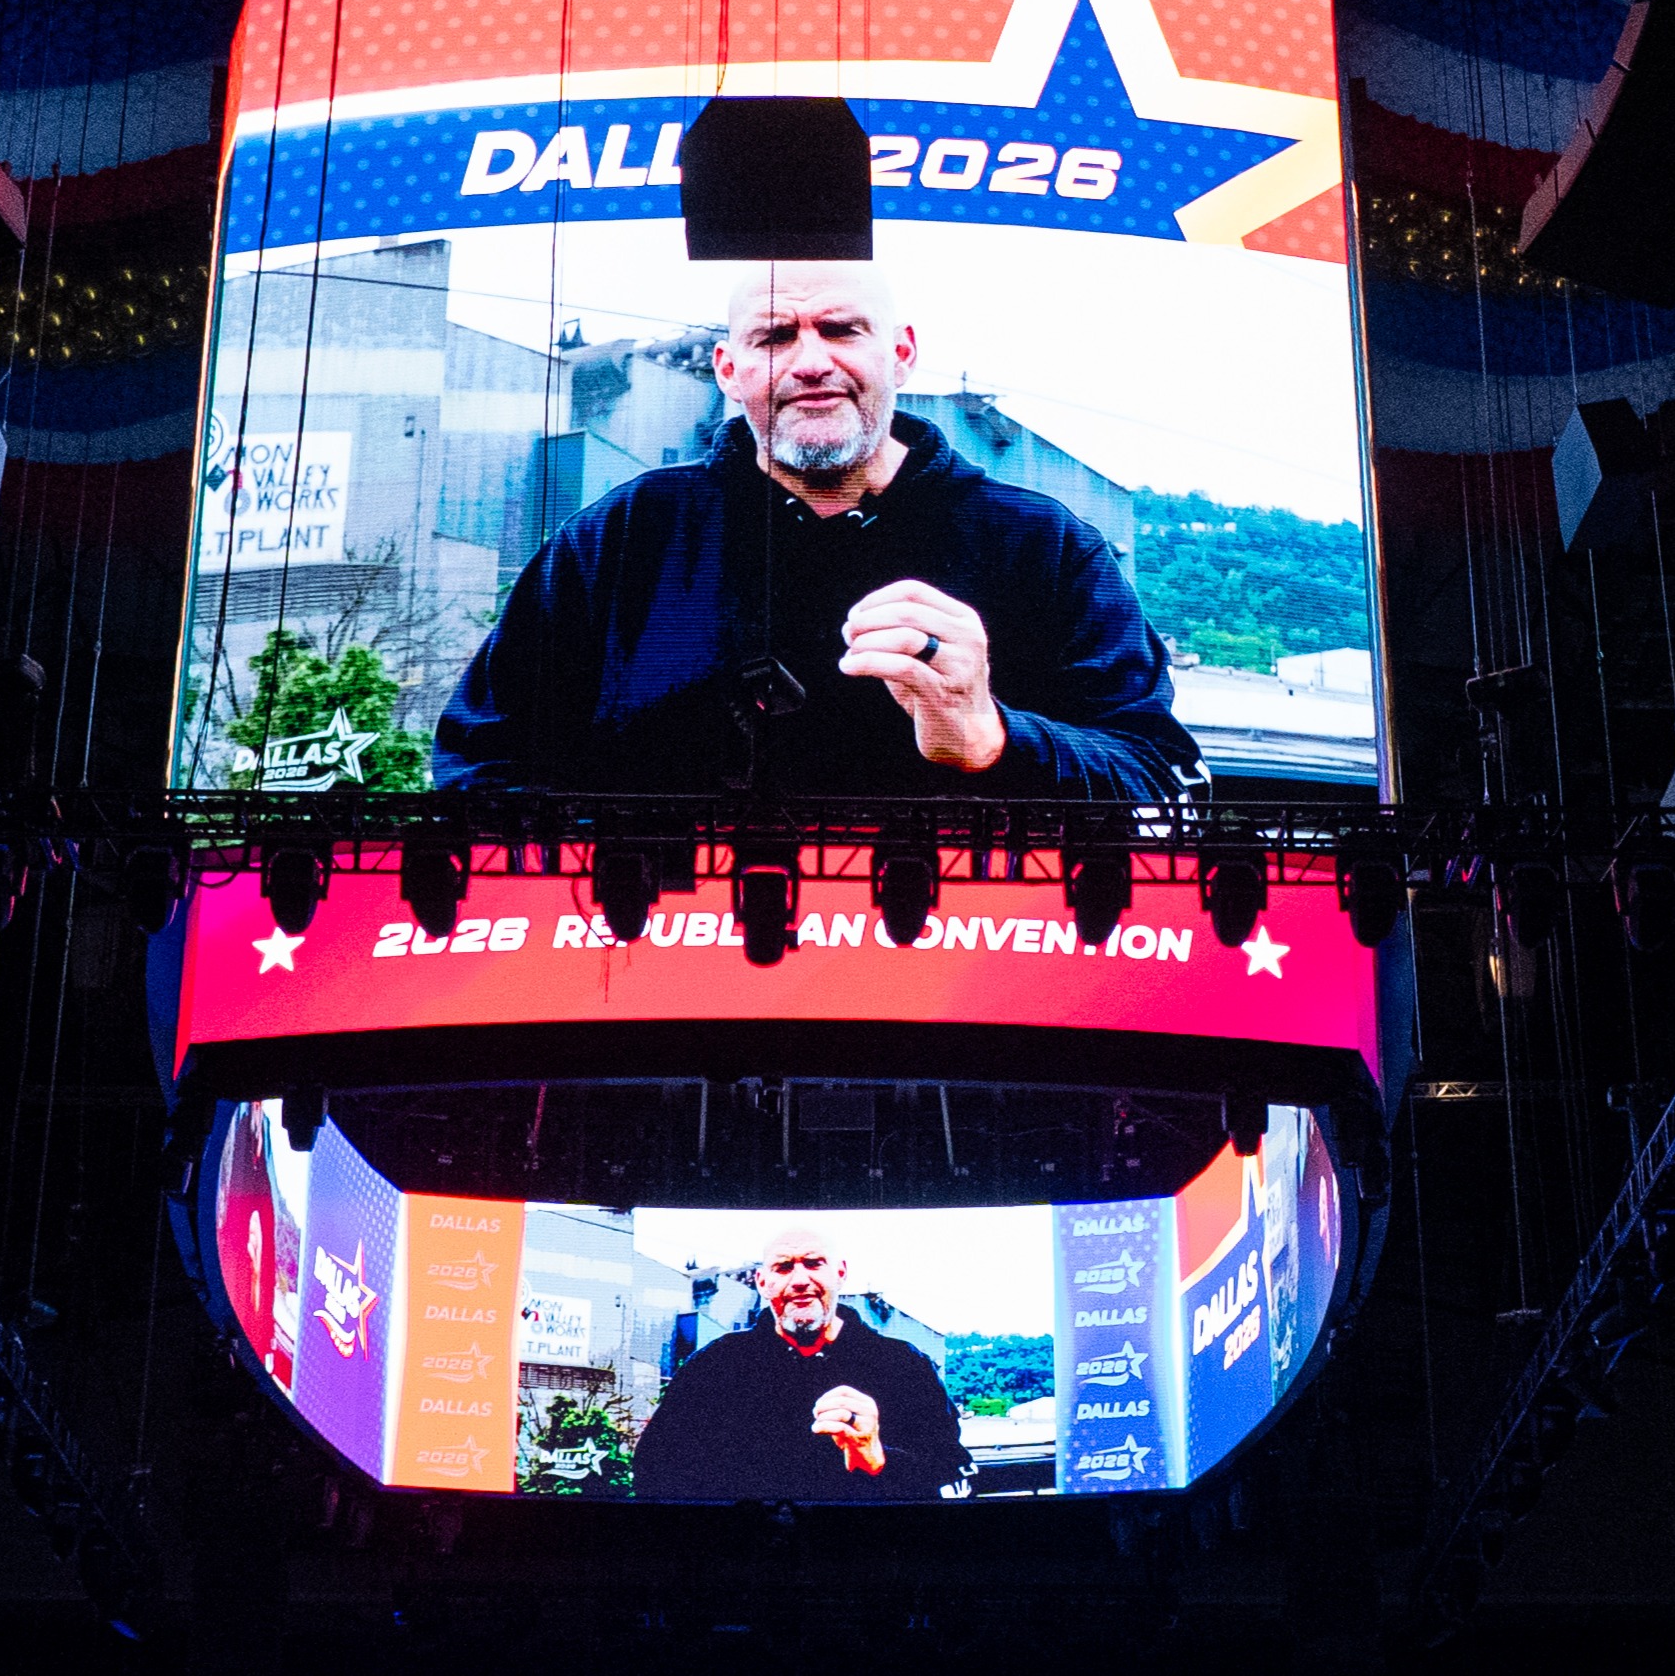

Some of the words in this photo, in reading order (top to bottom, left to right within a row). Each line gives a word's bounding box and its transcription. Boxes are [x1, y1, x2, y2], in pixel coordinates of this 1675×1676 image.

[461, 123, 682, 198] DALL
[870, 136, 1122, 202] 2026
[224, 443, 293, 467] MON
[253, 464, 330, 489] VALLEY
[257, 487, 339, 513] WORKS
[232, 740, 343, 773] DALLAS
[552, 912, 868, 948] REUBLAN
[874, 914, 1193, 962] ONVENION
[430, 1214, 501, 1233] DALLAS
[1072, 1217, 1147, 1237] DALLAS
[427, 1263, 478, 1278] 2026
[1074, 1266, 1126, 1284] 2026
[1192, 1250, 1258, 1356] DALLAS
[425, 1305, 497, 1324] DALLAS
[1075, 1306, 1148, 1328] DALLAS
[422, 1355, 474, 1370] 2026
[1076, 1359, 1129, 1377] 2026
[420, 1398, 493, 1417] DALLAS
[1077, 1399, 1151, 1421] DALLAS
[415, 1449, 468, 1464] 2026
[539, 1450, 592, 1465] DALLAS
[1078, 1453, 1131, 1471] 2026
